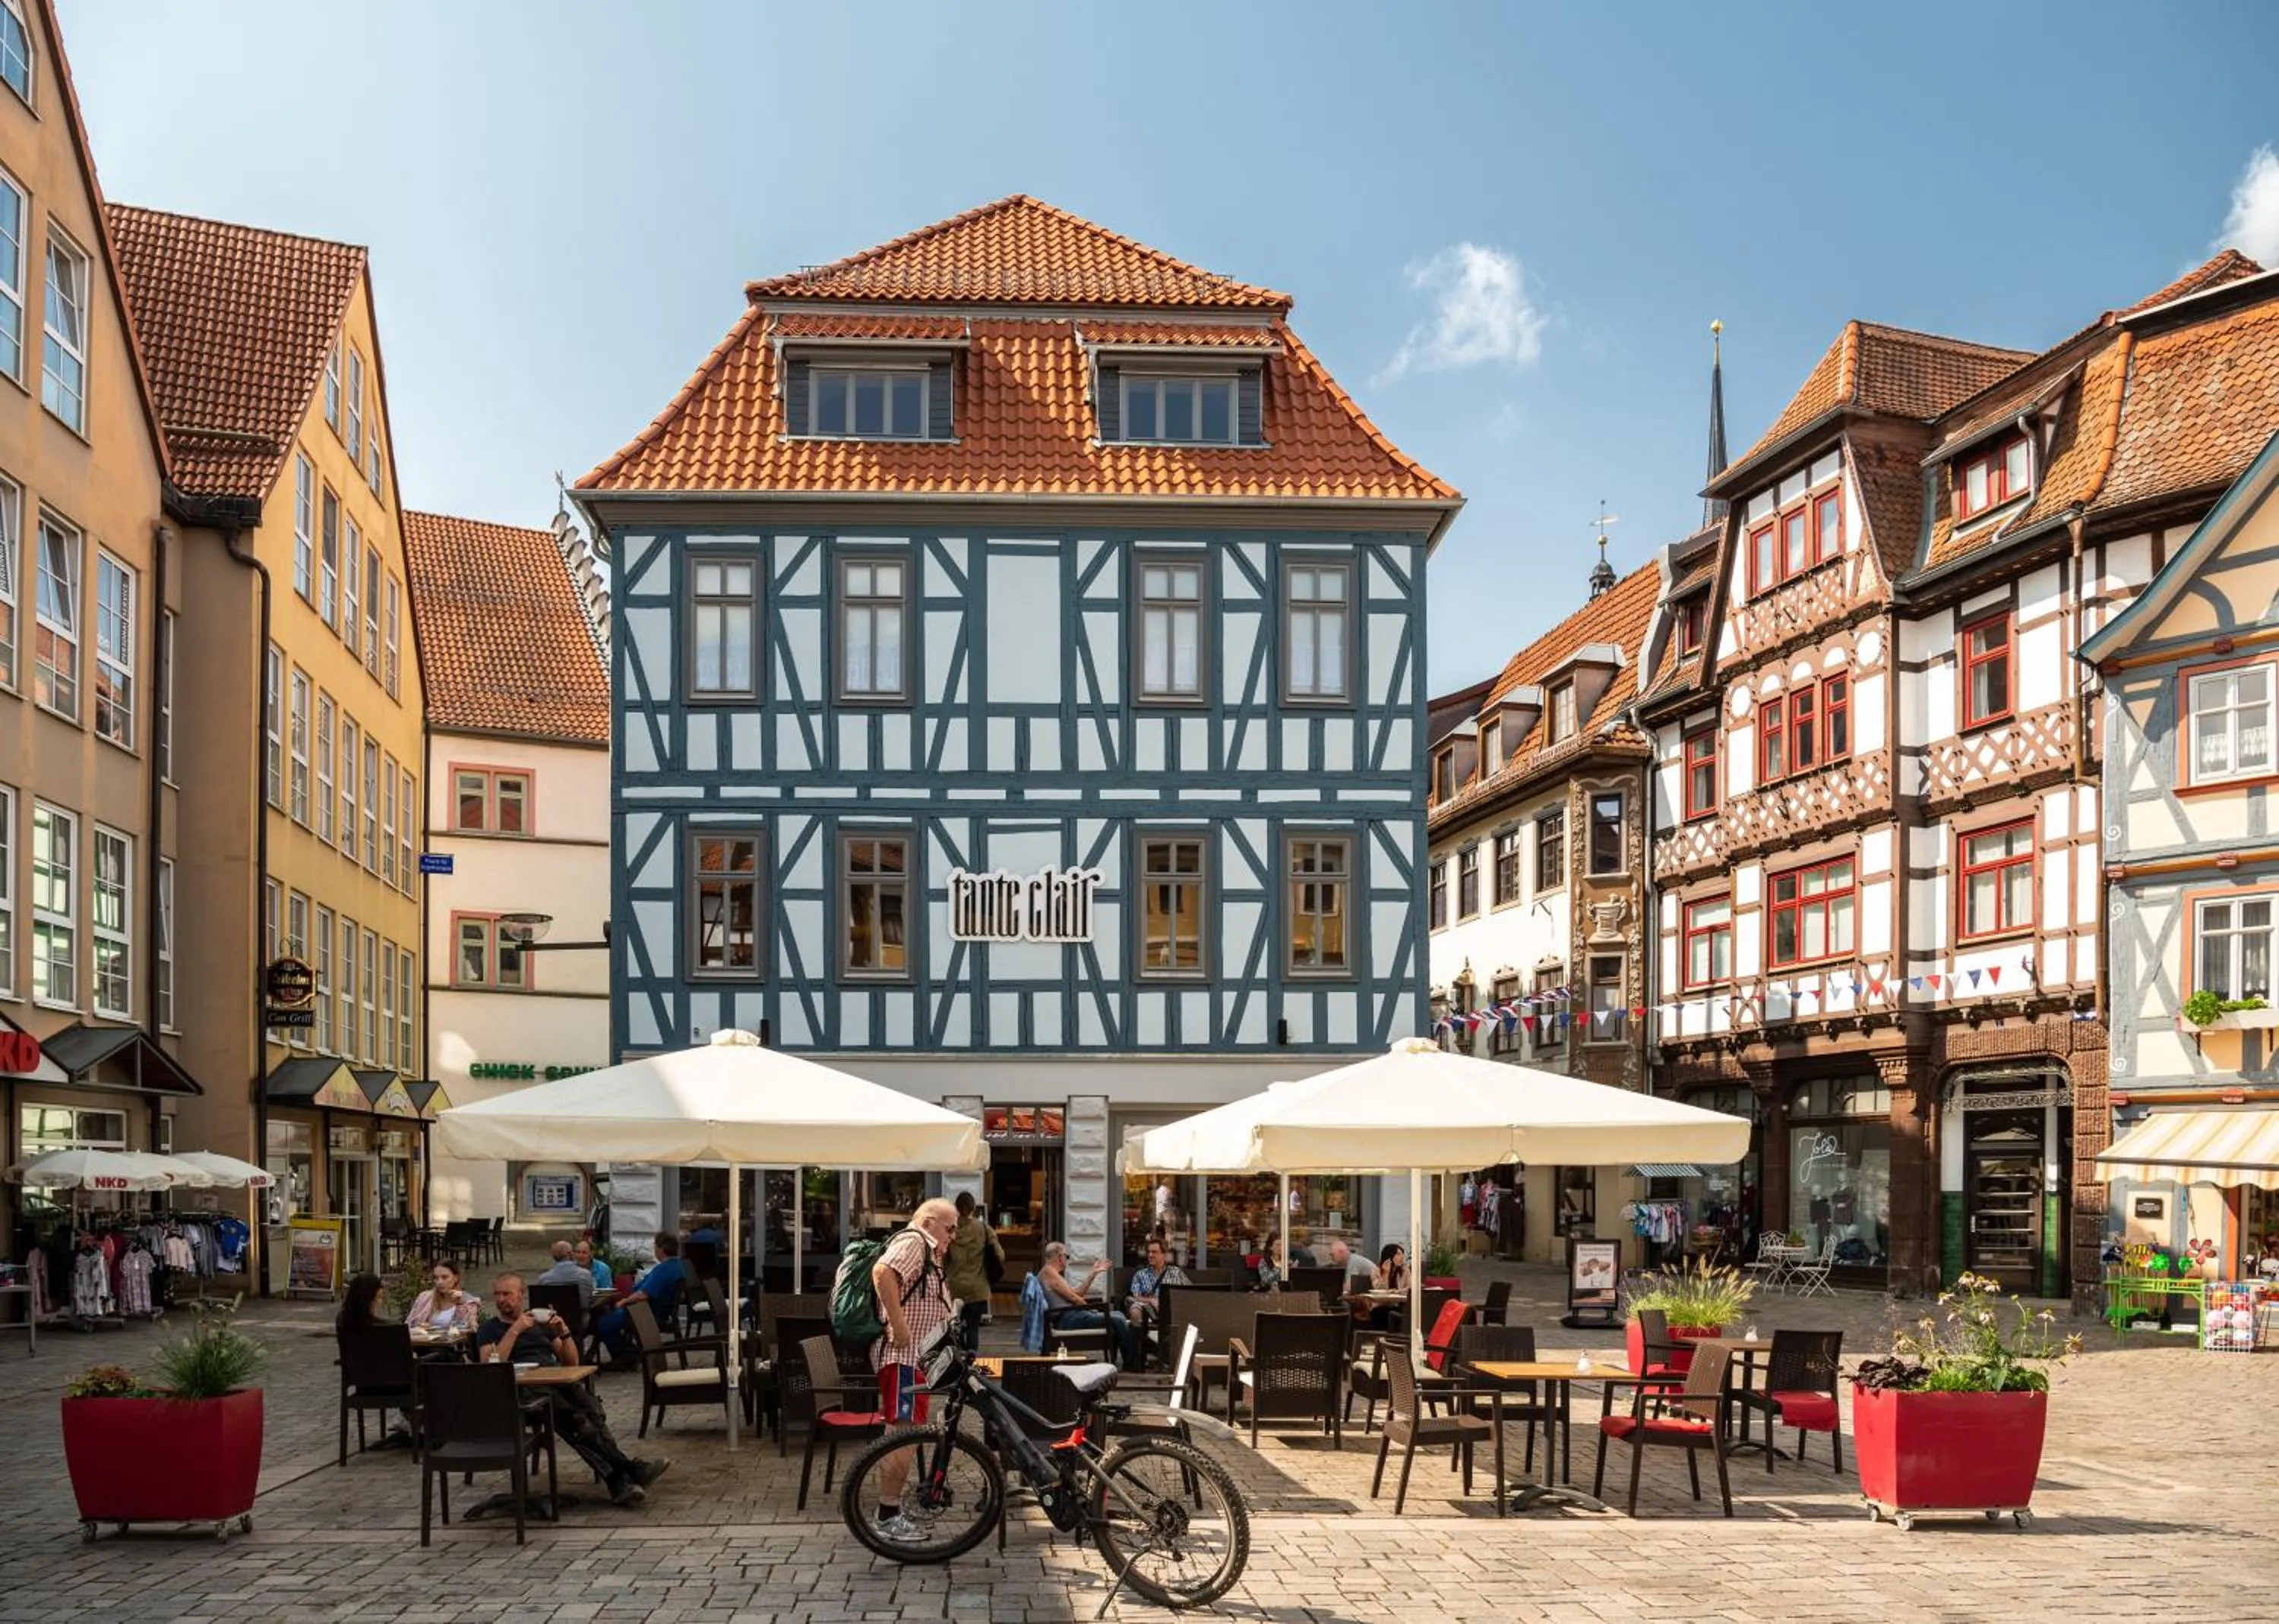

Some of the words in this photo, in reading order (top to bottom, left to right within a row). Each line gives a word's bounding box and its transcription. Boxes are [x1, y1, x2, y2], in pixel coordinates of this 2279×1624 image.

[953, 874, 1019, 937] tante
[1029, 871, 1100, 938] clair
[0, 1029, 40, 1073] KD
[95, 1177, 128, 1189] NKD
